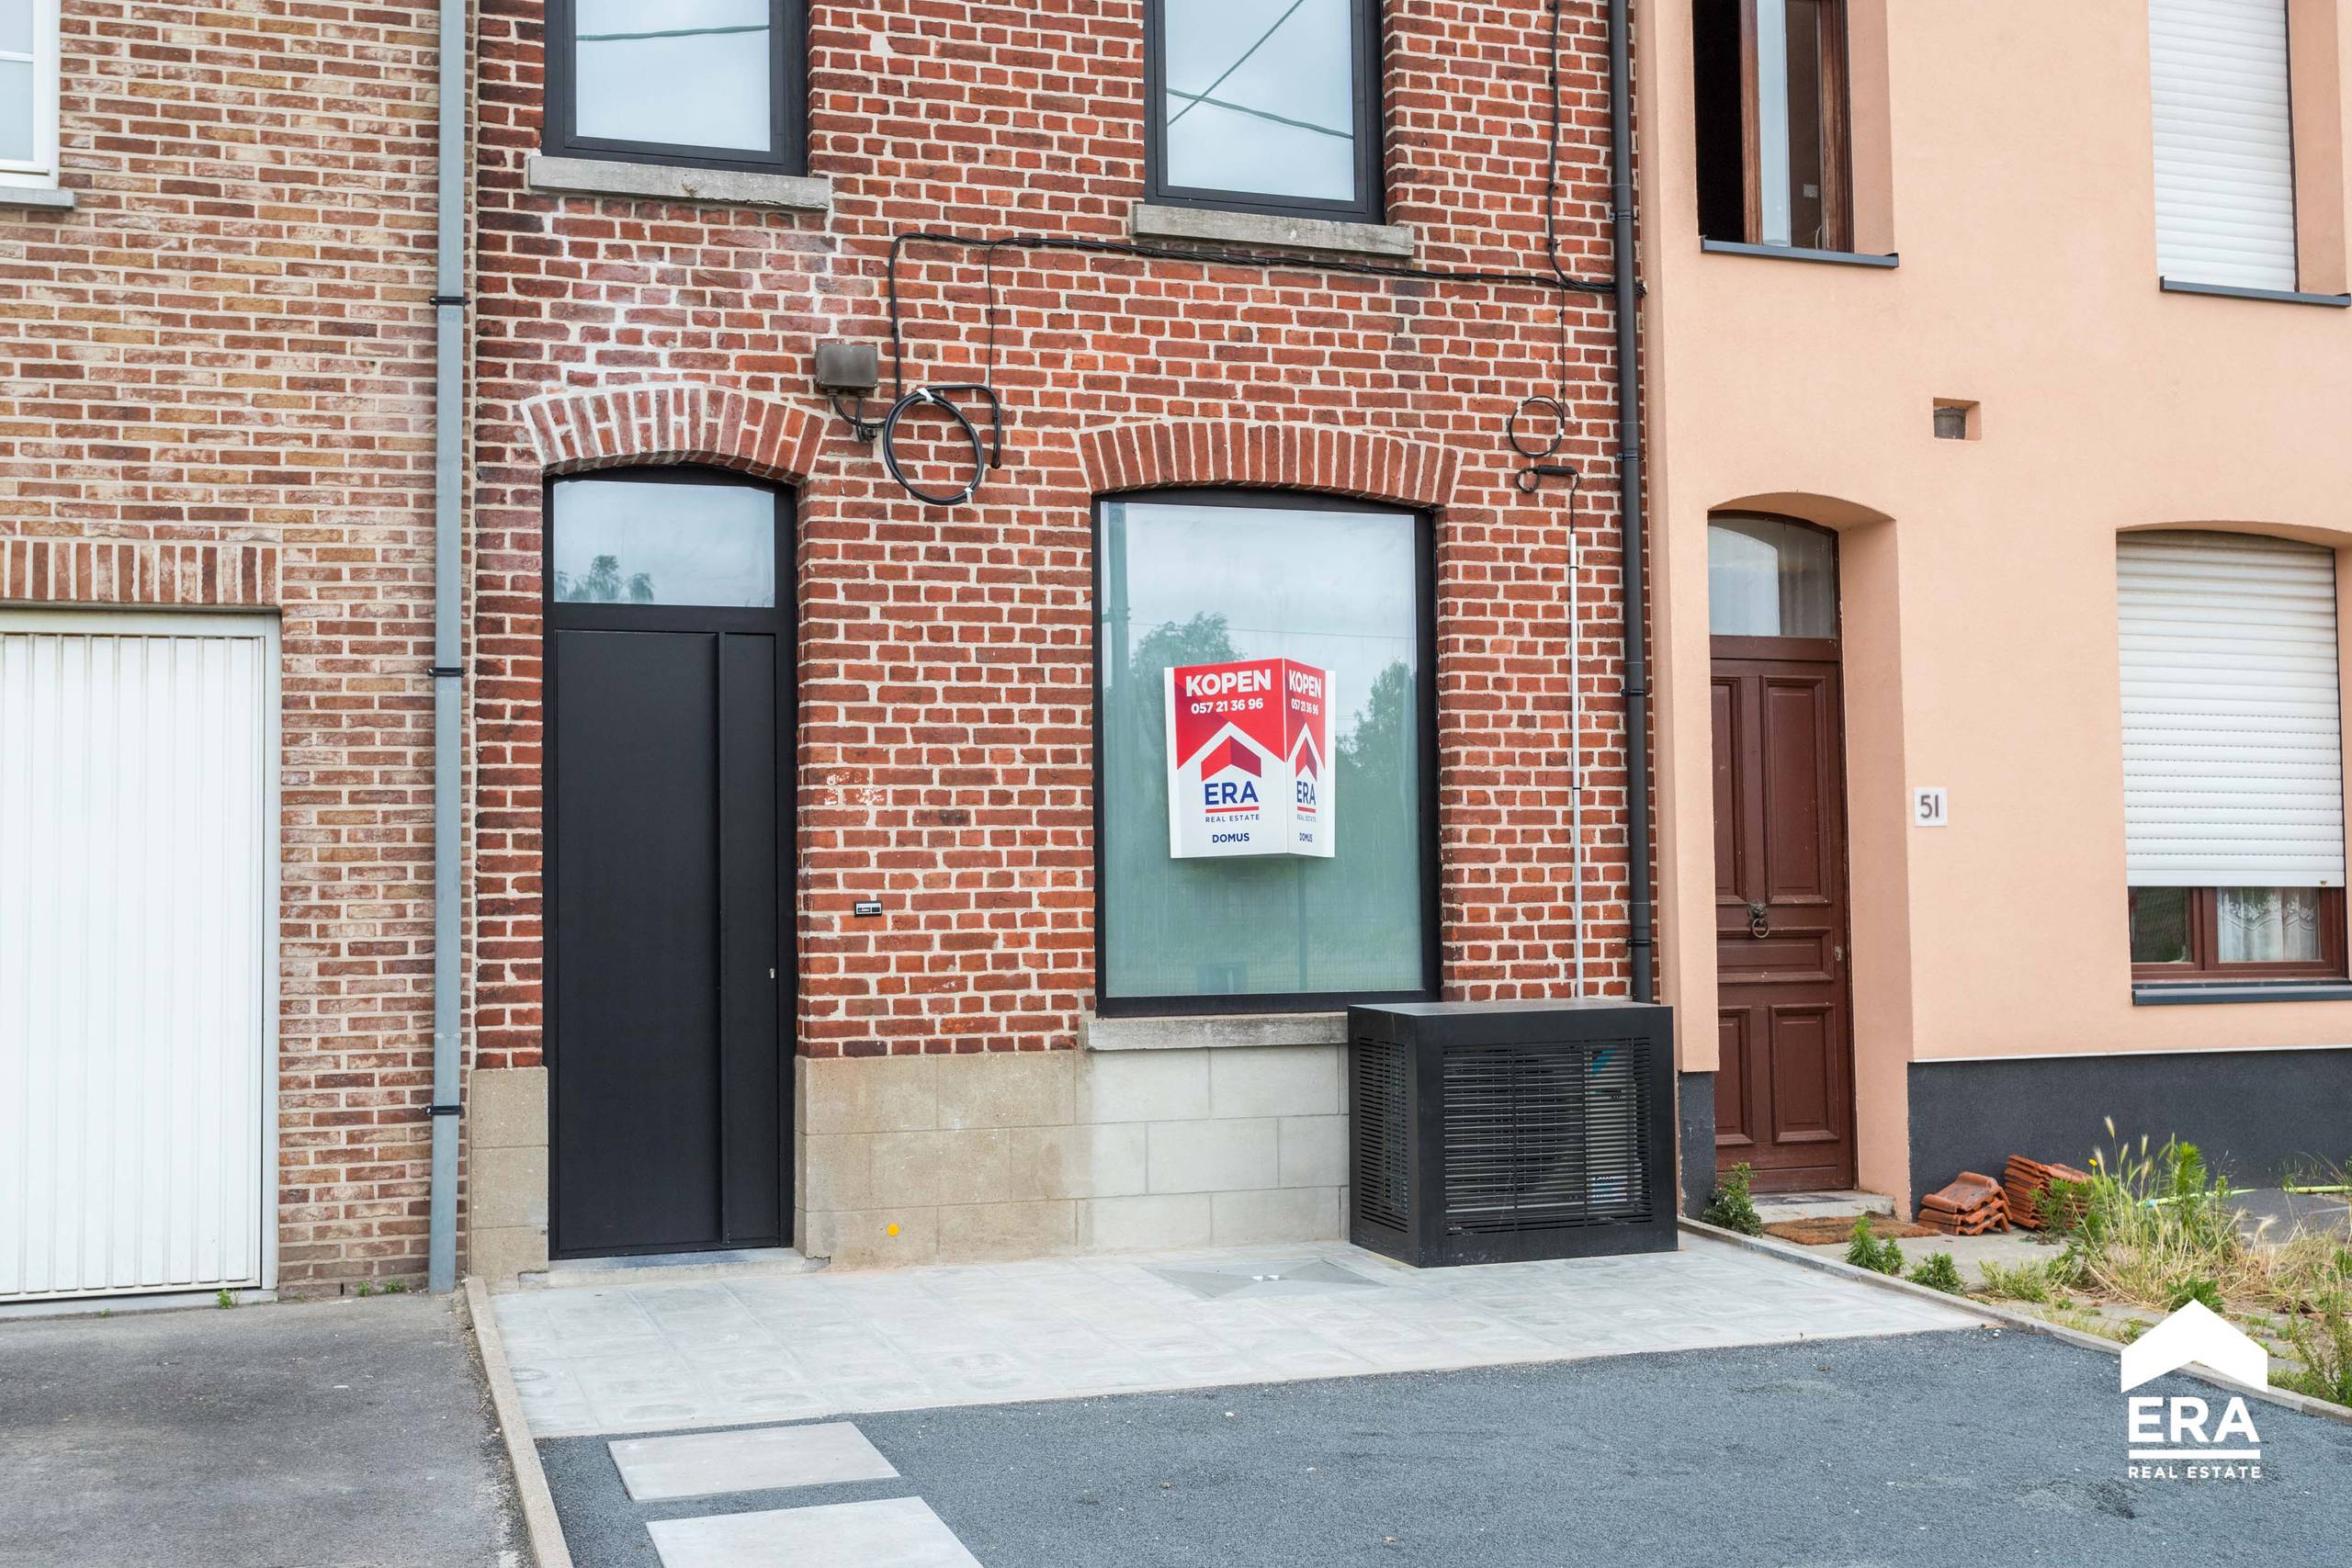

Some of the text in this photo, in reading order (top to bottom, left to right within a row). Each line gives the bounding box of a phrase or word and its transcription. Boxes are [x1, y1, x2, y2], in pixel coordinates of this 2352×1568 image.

[1185, 669, 1272, 697] KOPEN
[1289, 669, 1321, 699] KOPEN
[1191, 697, 1264, 715] 057 21 36 96
[1204, 780, 1259, 806] ERA
[1296, 781, 1317, 806] ERA
[1229, 814, 1261, 822] ESTATE
[1920, 794, 1939, 818] 51
[1212, 832, 1250, 843] DOMUS
